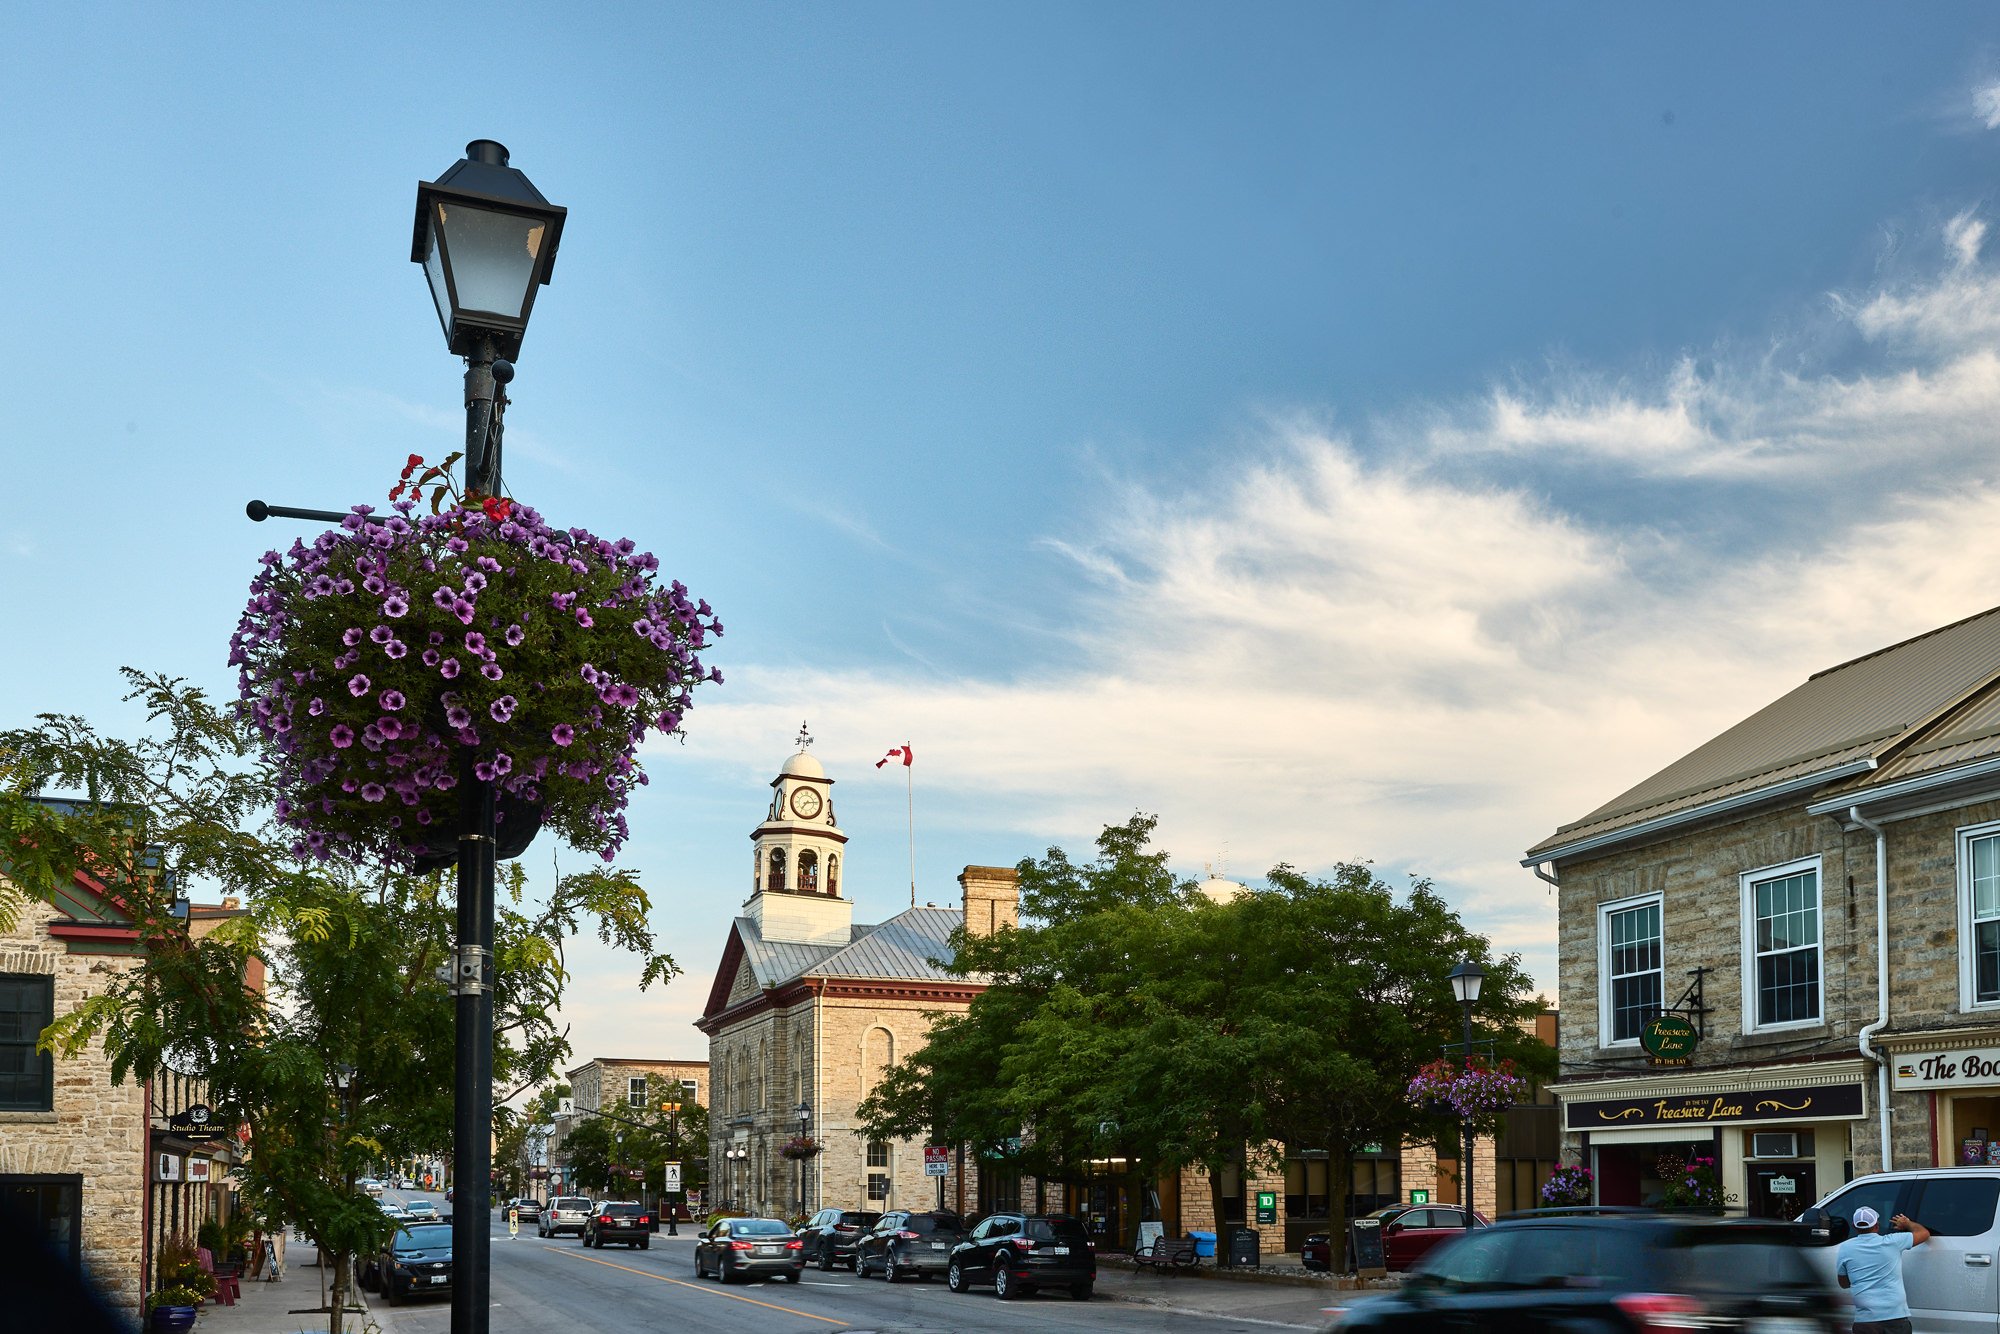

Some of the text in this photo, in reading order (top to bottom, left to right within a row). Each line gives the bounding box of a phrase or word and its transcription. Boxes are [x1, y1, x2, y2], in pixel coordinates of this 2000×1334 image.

[1652, 1022, 1690, 1036] Treasure
[1658, 1037, 1684, 1051] Lane
[1919, 1054, 1957, 1080] The
[1653, 1097, 1743, 1121] Treasure Lane
[171, 1123, 225, 1132] Studio Theatr
[1260, 1196, 1273, 1206] TD
[1414, 1194, 1425, 1203] TD
[1725, 1193, 1738, 1202] 62
